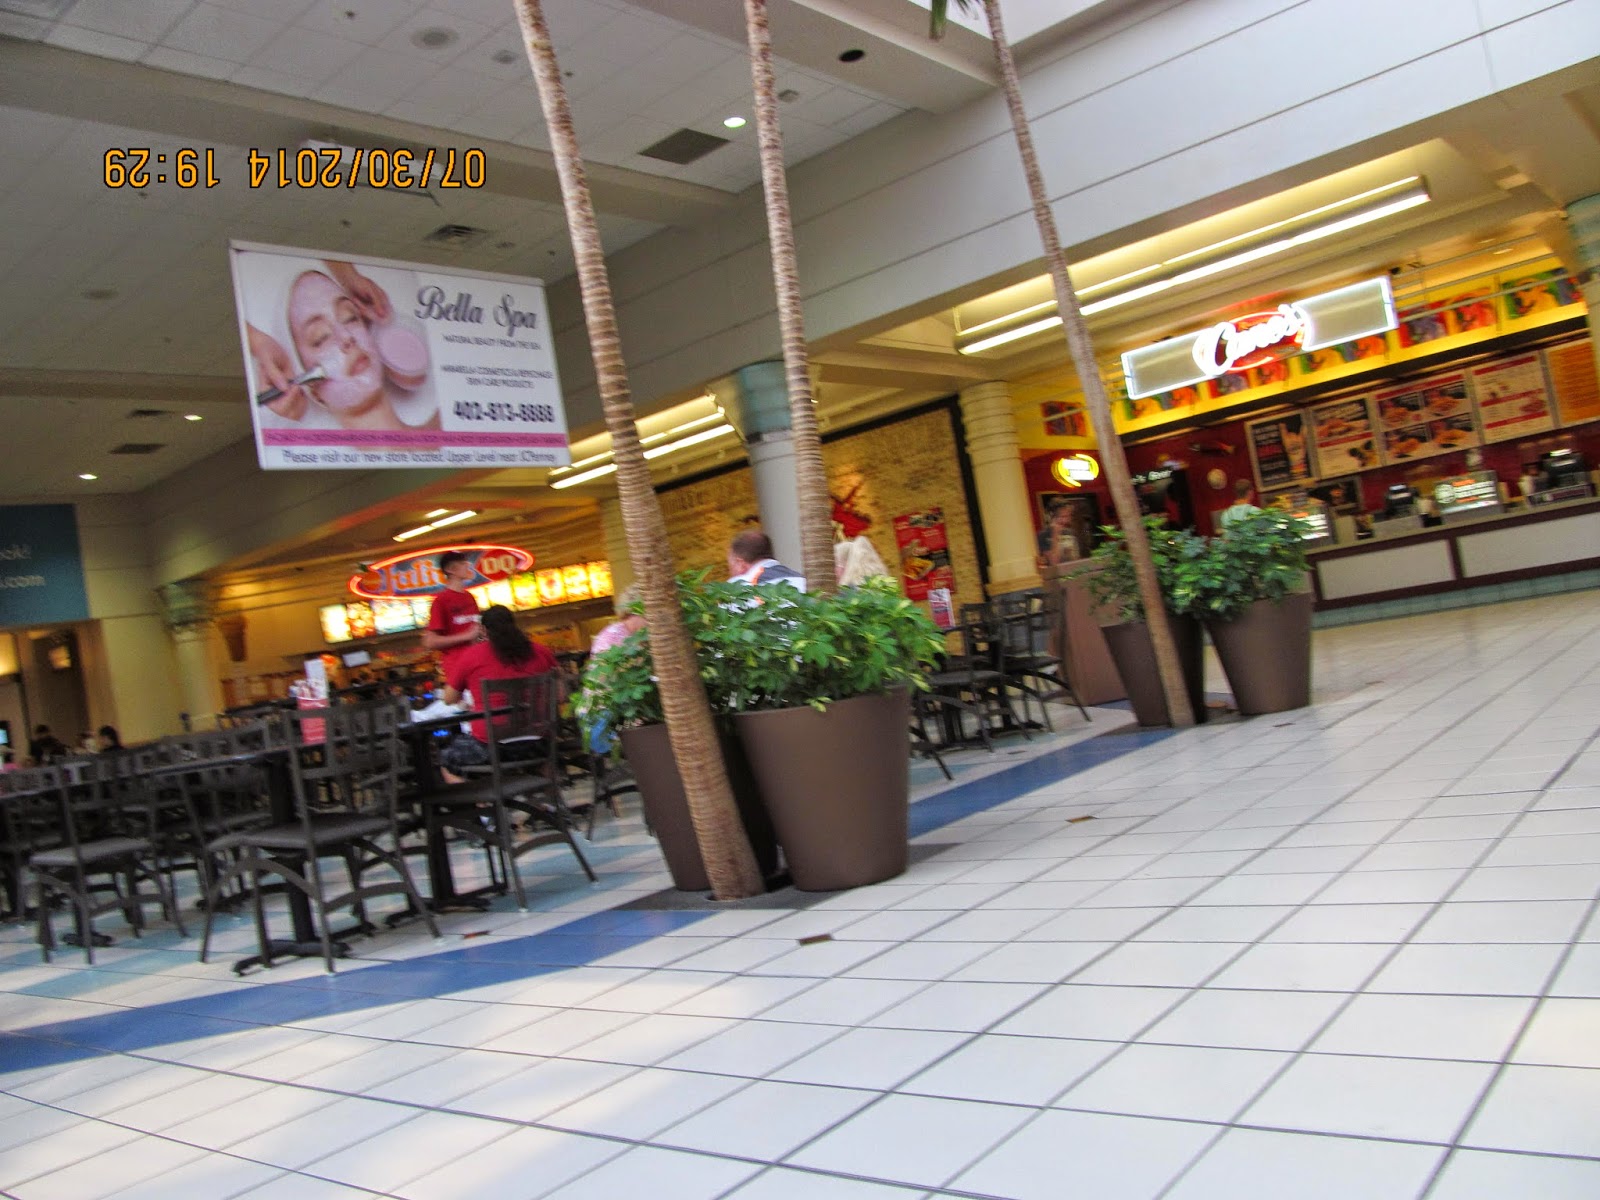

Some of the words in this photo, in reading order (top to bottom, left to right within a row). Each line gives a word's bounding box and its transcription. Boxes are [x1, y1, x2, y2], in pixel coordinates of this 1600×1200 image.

[414, 285, 483, 324] Bella
[493, 294, 537, 337] Spa
[282, 449, 318, 463] Please
[320, 450, 341, 463] visit
[342, 453, 360, 463] our
[363, 453, 382, 462] new
[482, 555, 515, 575] DQ
